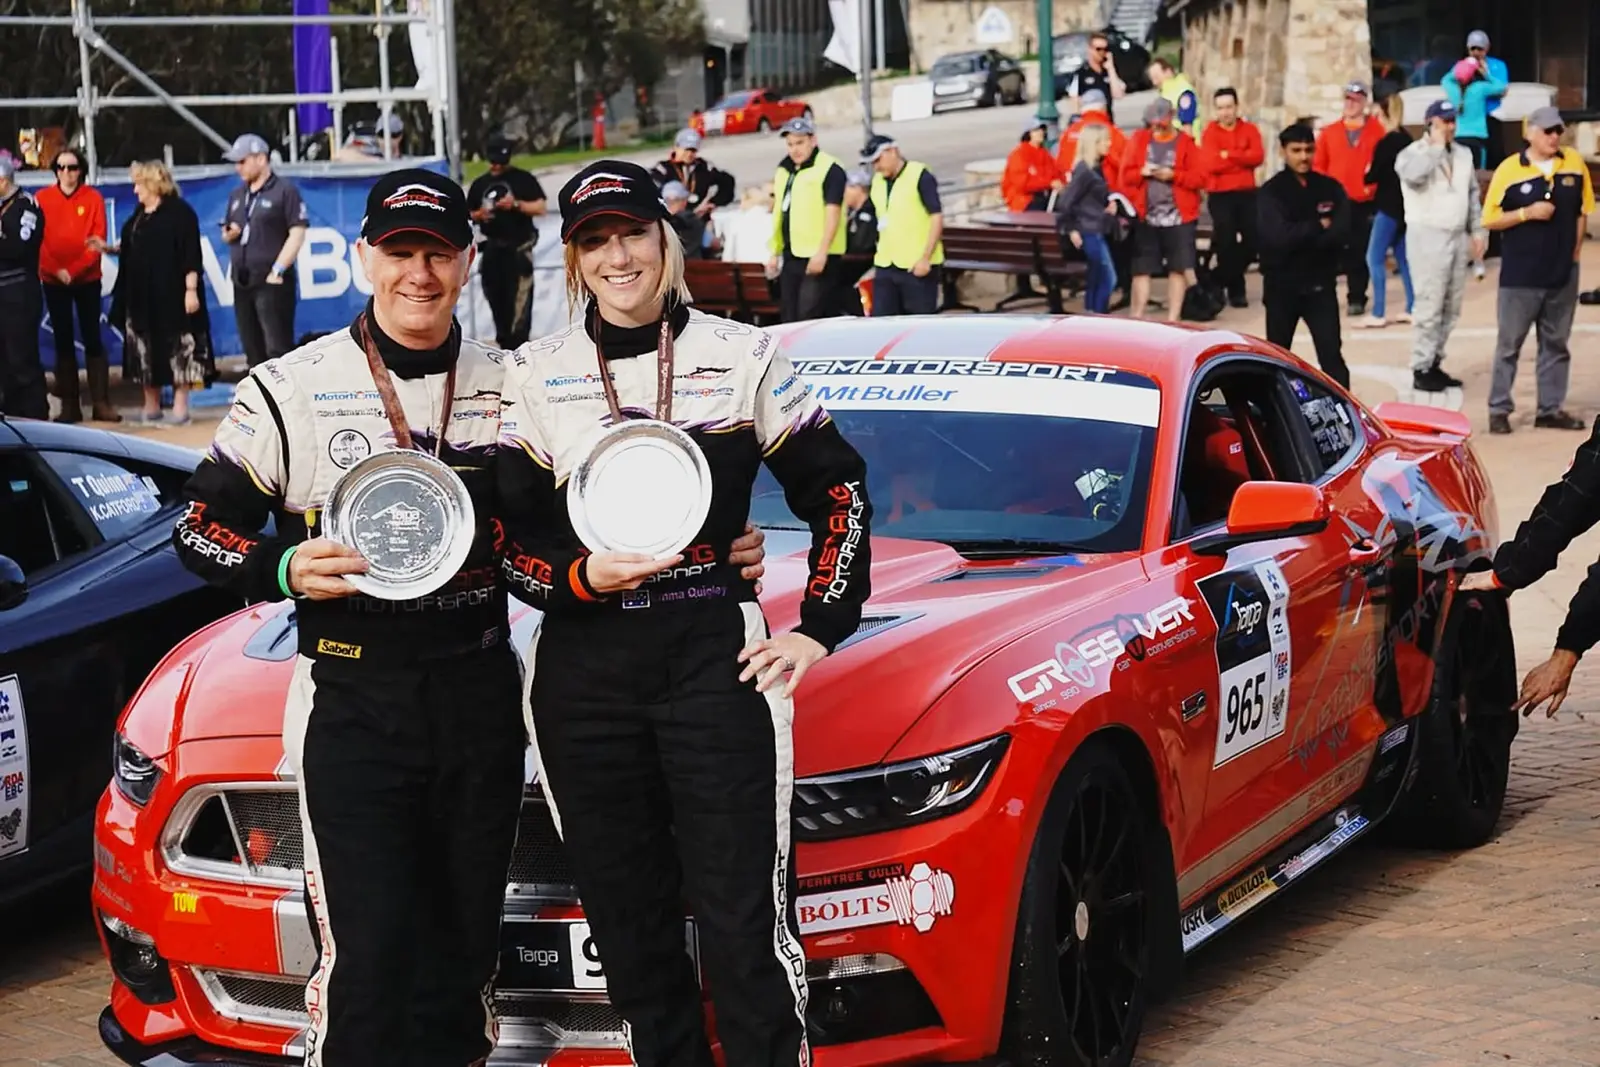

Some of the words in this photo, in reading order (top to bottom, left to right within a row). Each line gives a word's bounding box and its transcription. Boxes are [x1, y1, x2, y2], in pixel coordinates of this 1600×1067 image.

[816, 386, 859, 401] Mt
[861, 384, 958, 401] Buller
[71, 477, 90, 498] T
[85, 473, 128, 498] Quinn
[1231, 601, 1263, 635] Targa
[1224, 671, 1266, 744] 965
[1331, 814, 1369, 844] STEEDA
[868, 863, 904, 880] GULLY
[1227, 869, 1267, 907] DUNLOP
[173, 891, 199, 914] TOW
[799, 894, 890, 924] BOLTS
[516, 946, 559, 967] Targa
